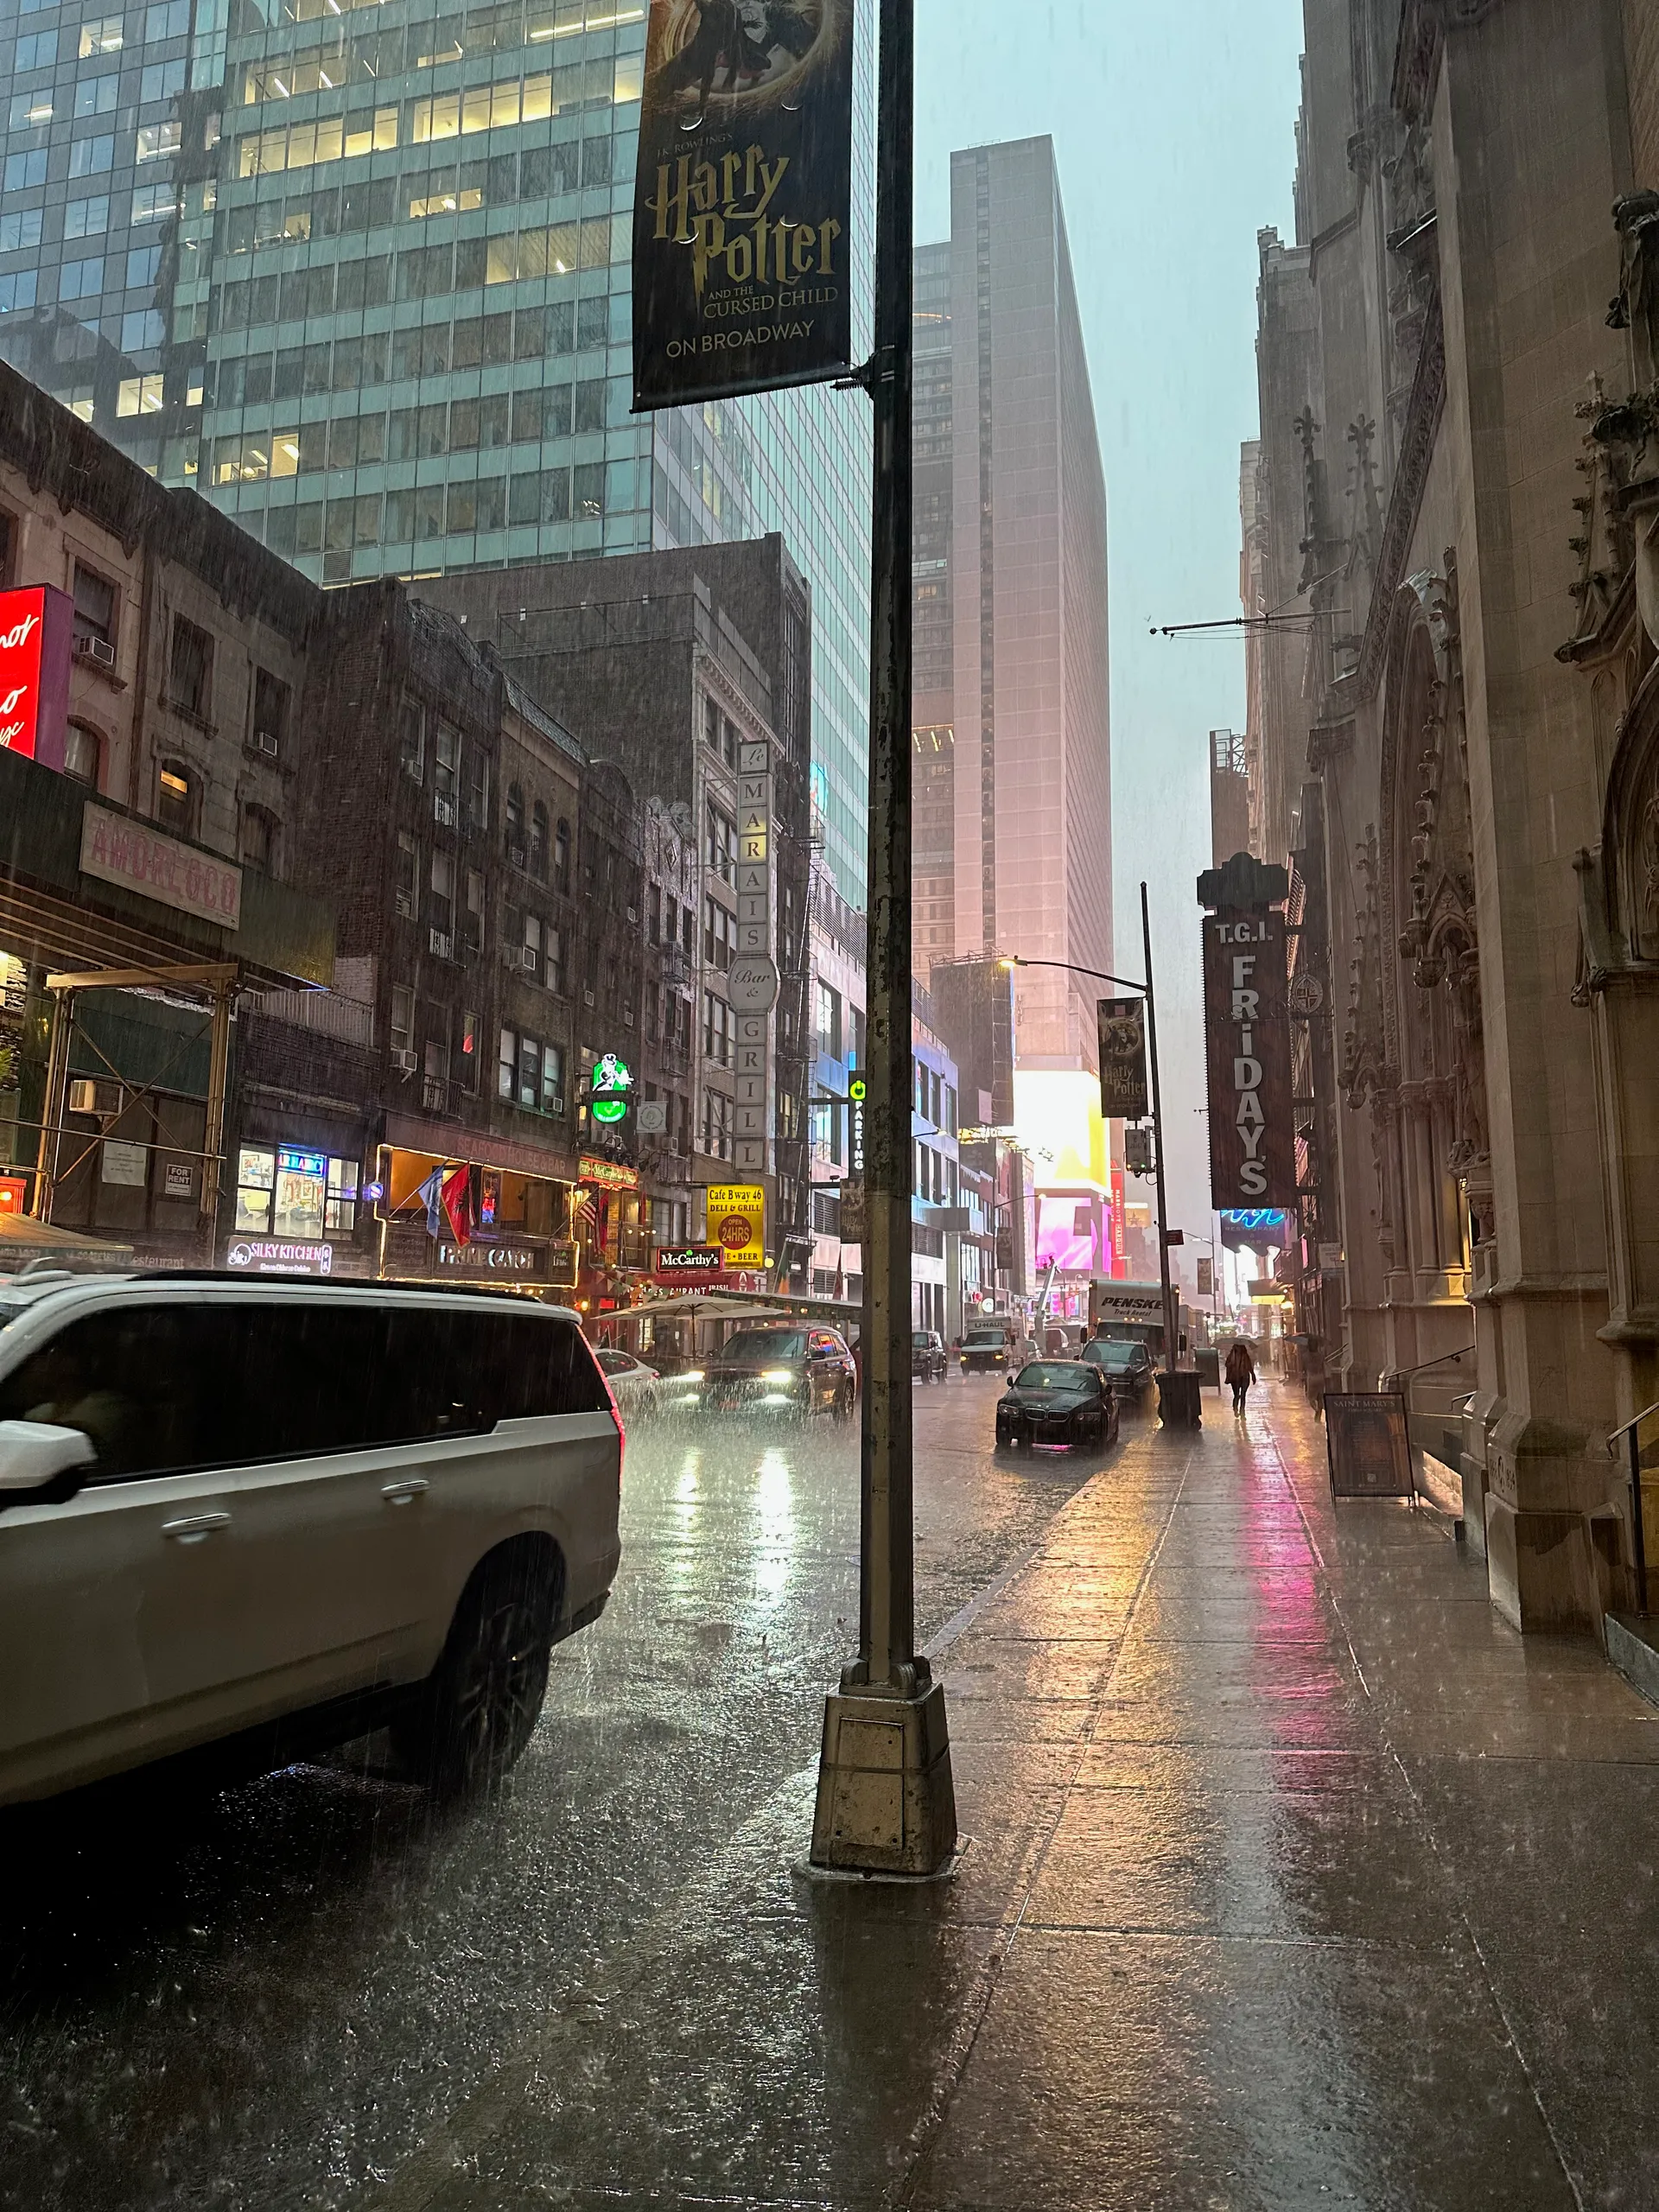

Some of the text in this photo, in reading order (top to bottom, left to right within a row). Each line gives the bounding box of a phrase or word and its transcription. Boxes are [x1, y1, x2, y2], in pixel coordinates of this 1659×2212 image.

[674, 133, 734, 154] ROWLING'S
[645, 143, 790, 242] Harry
[690, 212, 842, 314] Potter
[703, 286, 839, 319] CURSED CHILD
[709, 284, 754, 302] AND THE
[666, 319, 815, 358] ON BROADWAY
[742, 747, 764, 766] Le
[744, 783, 763, 946] MARAIS
[1215, 921, 1274, 944] T.G.I.
[734, 969, 771, 984] Bar
[747, 987, 759, 997] &
[1103, 1065, 1135, 1085] Harry
[744, 1021, 760, 1163] GRILL
[1113, 1078, 1146, 1098] Potter
[855, 1100, 864, 1170] PARKING
[456, 1136, 507, 1161] SEAFOOD
[549, 1159, 567, 1174] BAR
[168, 1175, 190, 1185] RENT
[171, 1166, 188, 1177] FOR
[753, 1189, 762, 1200] 46
[721, 1226, 750, 1243] 24HRS
[251, 1242, 280, 1259] SILKY
[279, 1244, 322, 1262] KITCHEN
[662, 1253, 719, 1267] McCarthy's
[738, 1252, 758, 1261] BEER
[1101, 1297, 1164, 1310] PENSKE
[1333, 1399, 1395, 1408] SAINT MARY'S
